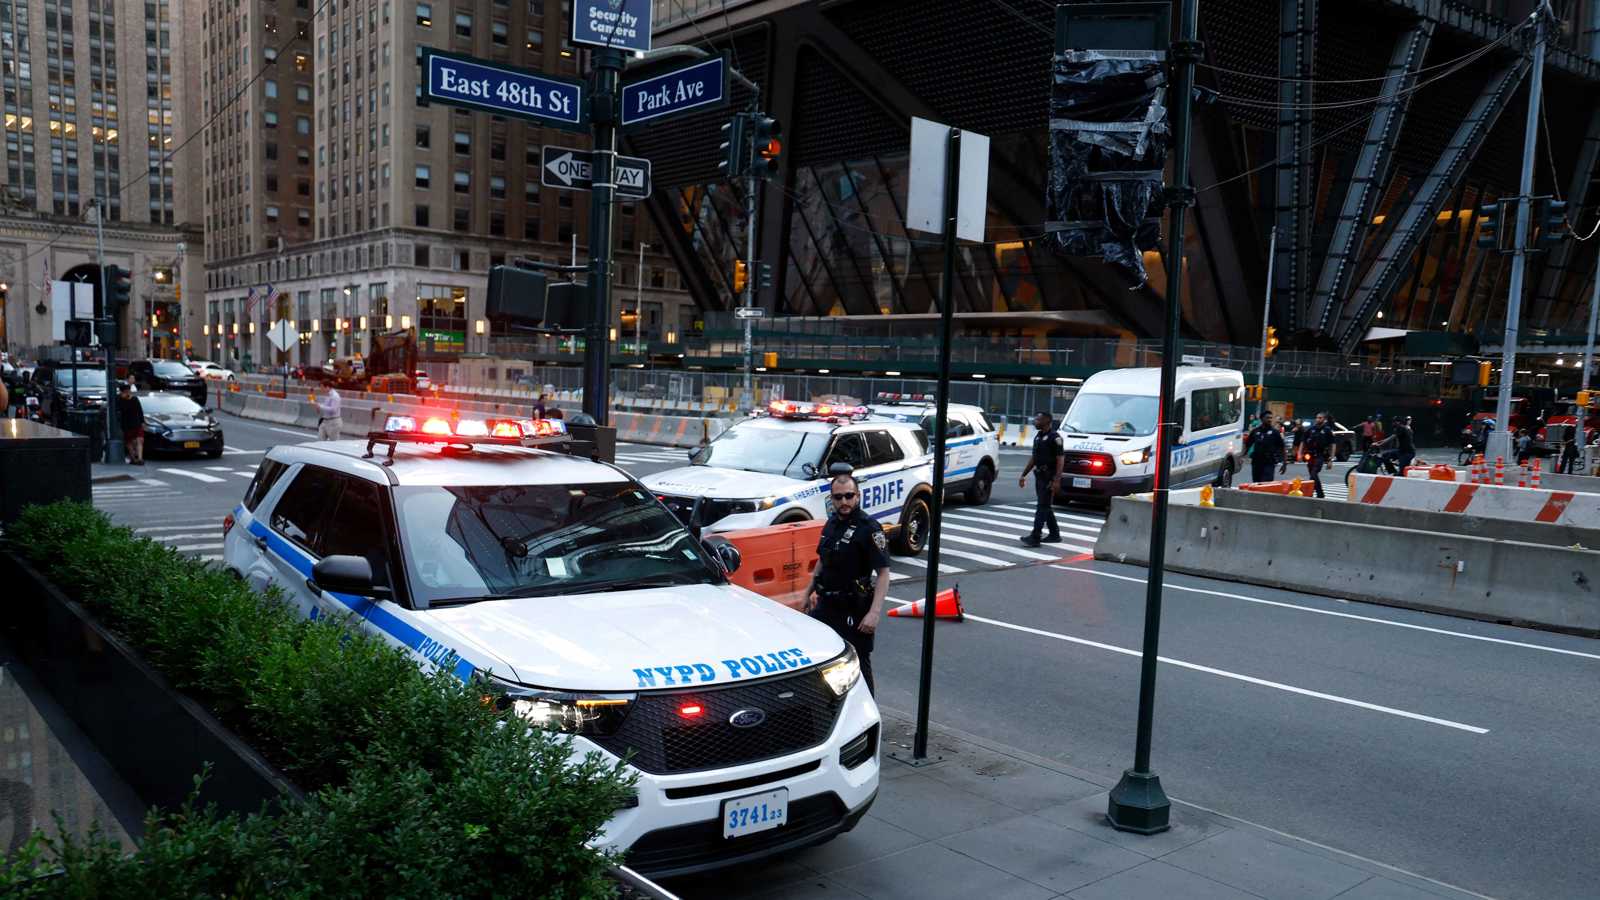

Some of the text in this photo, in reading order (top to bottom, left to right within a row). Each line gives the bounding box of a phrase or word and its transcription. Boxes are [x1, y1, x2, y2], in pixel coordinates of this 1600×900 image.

[589, 6, 638, 28] Security
[590, 20, 637, 38] Camera
[440, 67, 571, 114] East 48th St
[637, 80, 704, 113] Park Ave
[558, 160, 640, 185] ONE AY
[862, 479, 904, 509] ERIFF
[632, 647, 813, 688] NYPD POLICE
[729, 804, 768, 829] 3741
